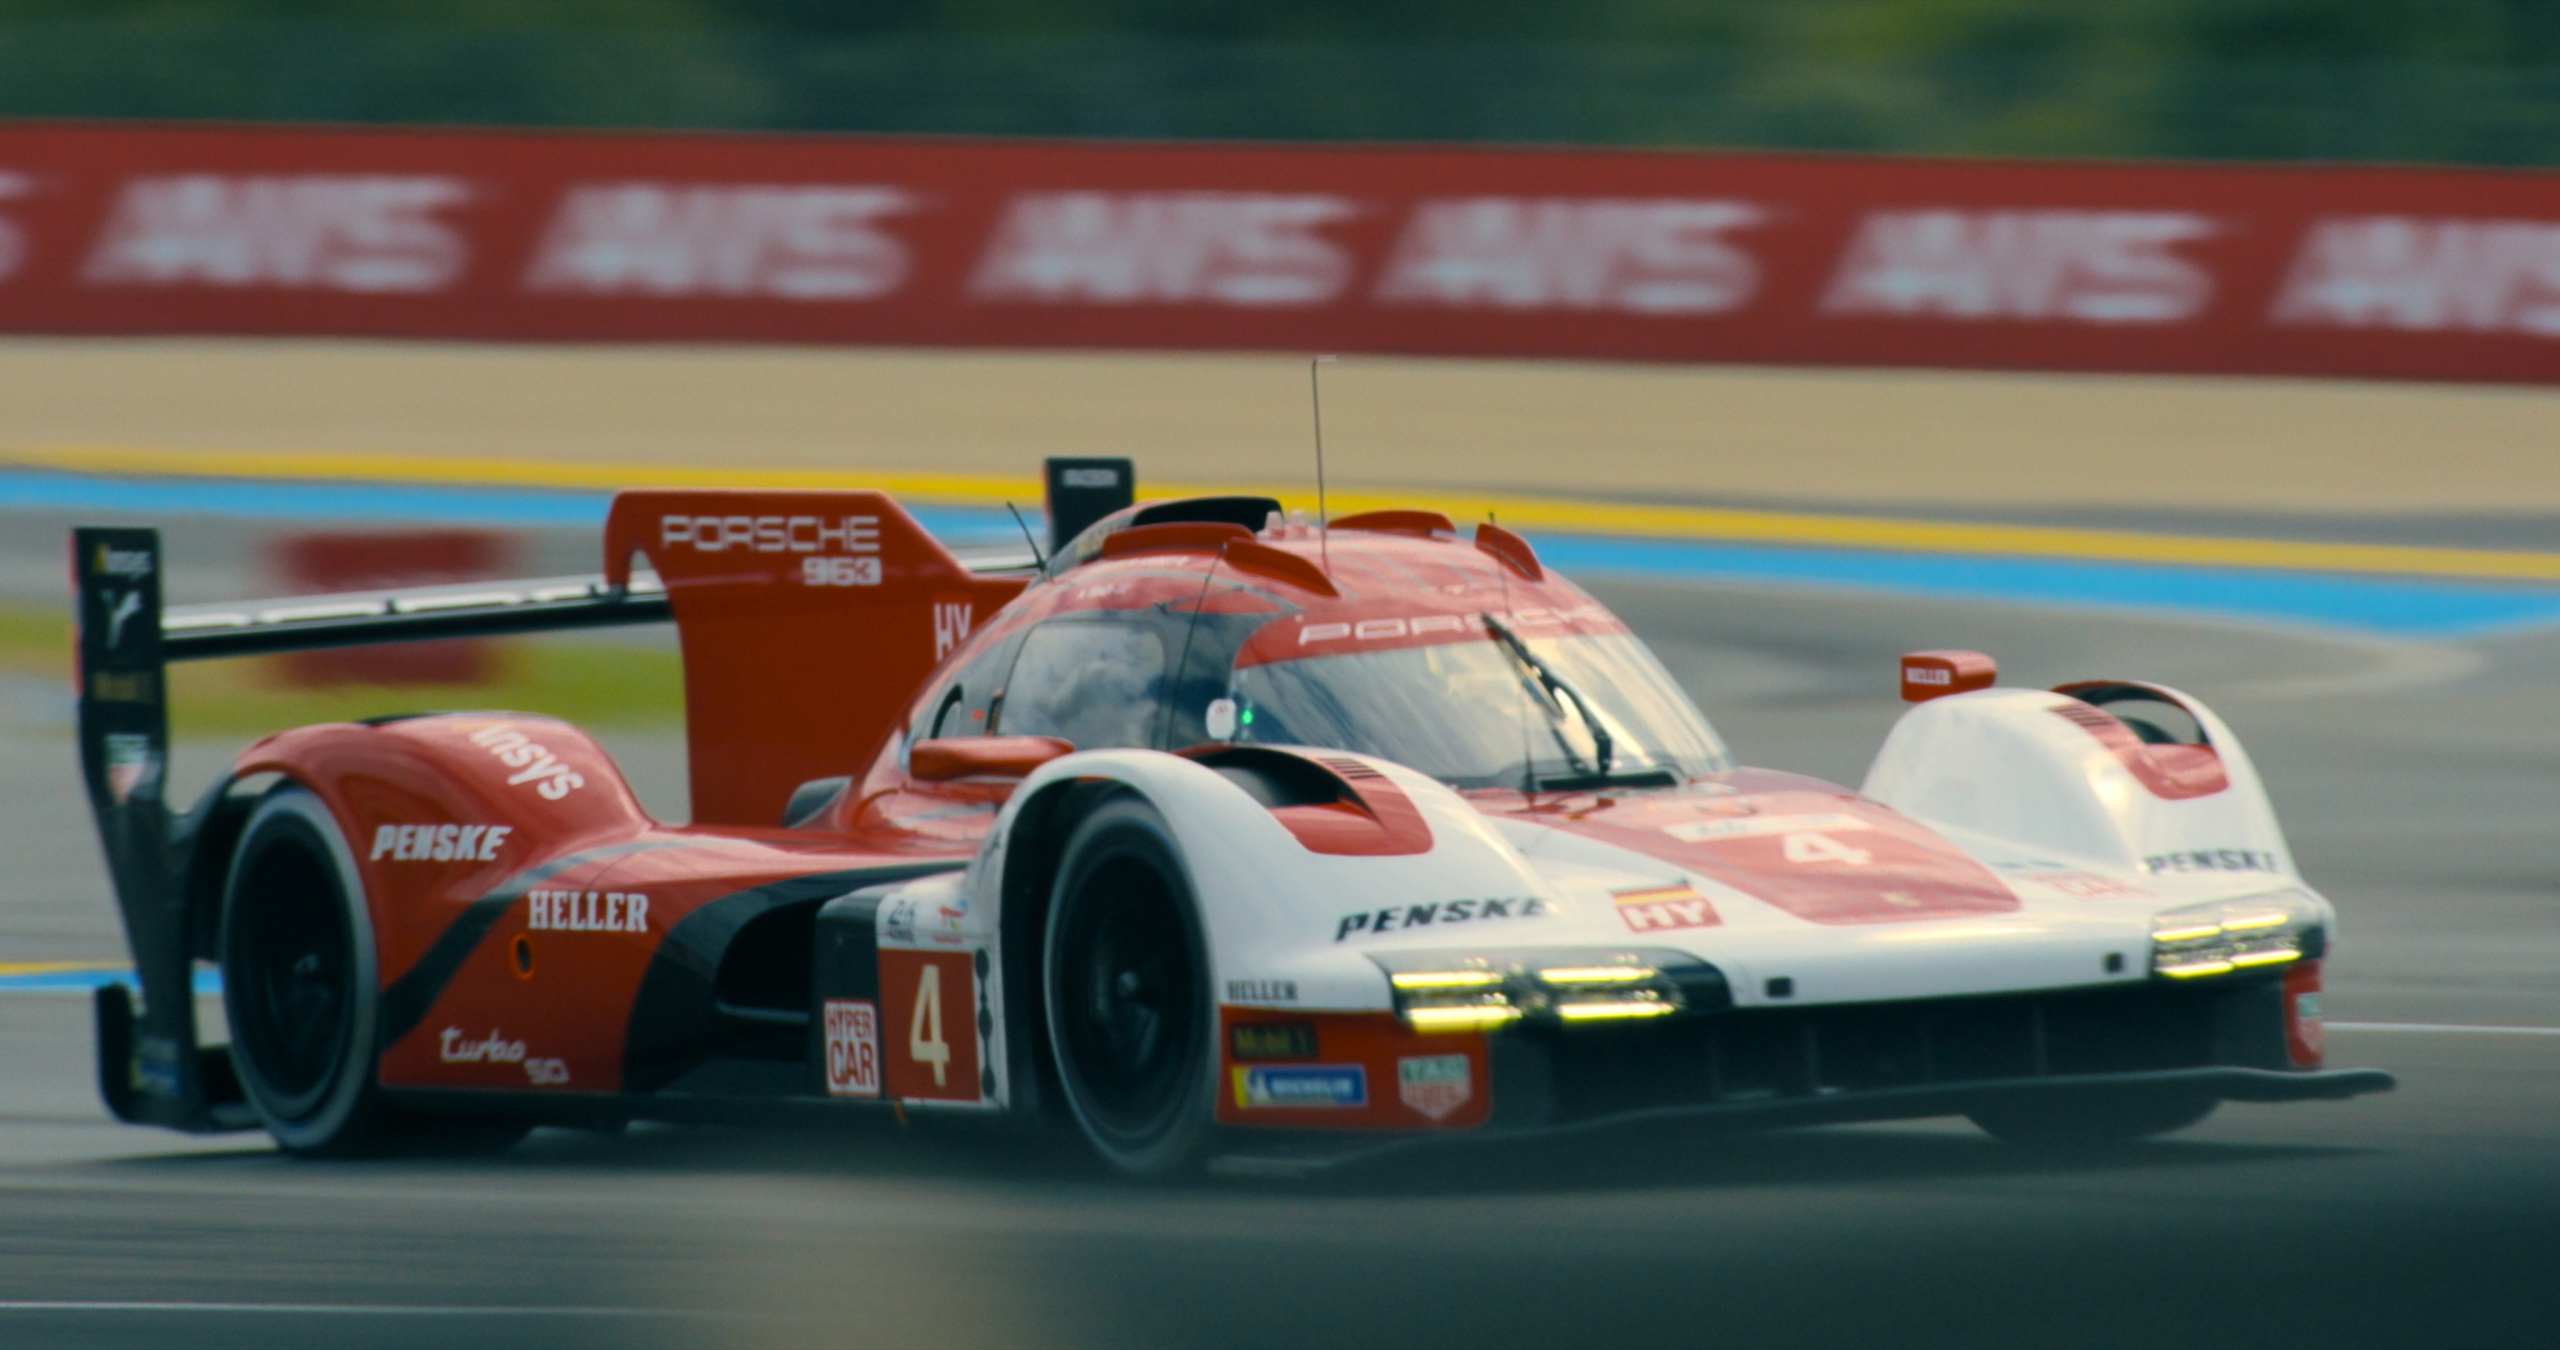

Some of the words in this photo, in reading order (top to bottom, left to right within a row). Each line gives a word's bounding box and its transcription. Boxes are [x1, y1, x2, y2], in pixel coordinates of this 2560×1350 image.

[661, 515, 881, 552] PORSCHE
[802, 556, 882, 586] 963
[370, 823, 513, 862] PENSKE
[1783, 832, 1873, 865] 4
[2143, 848, 2281, 876] PENSKE
[527, 889, 650, 933] HELLER
[1334, 897, 1548, 943] PENSKE
[1622, 899, 1707, 930] HY
[1226, 979, 1299, 1002] HELLER
[826, 1006, 873, 1039] HYPER
[909, 963, 951, 1088] 4
[440, 1025, 526, 1063] turbo
[829, 1039, 876, 1087] CAR
